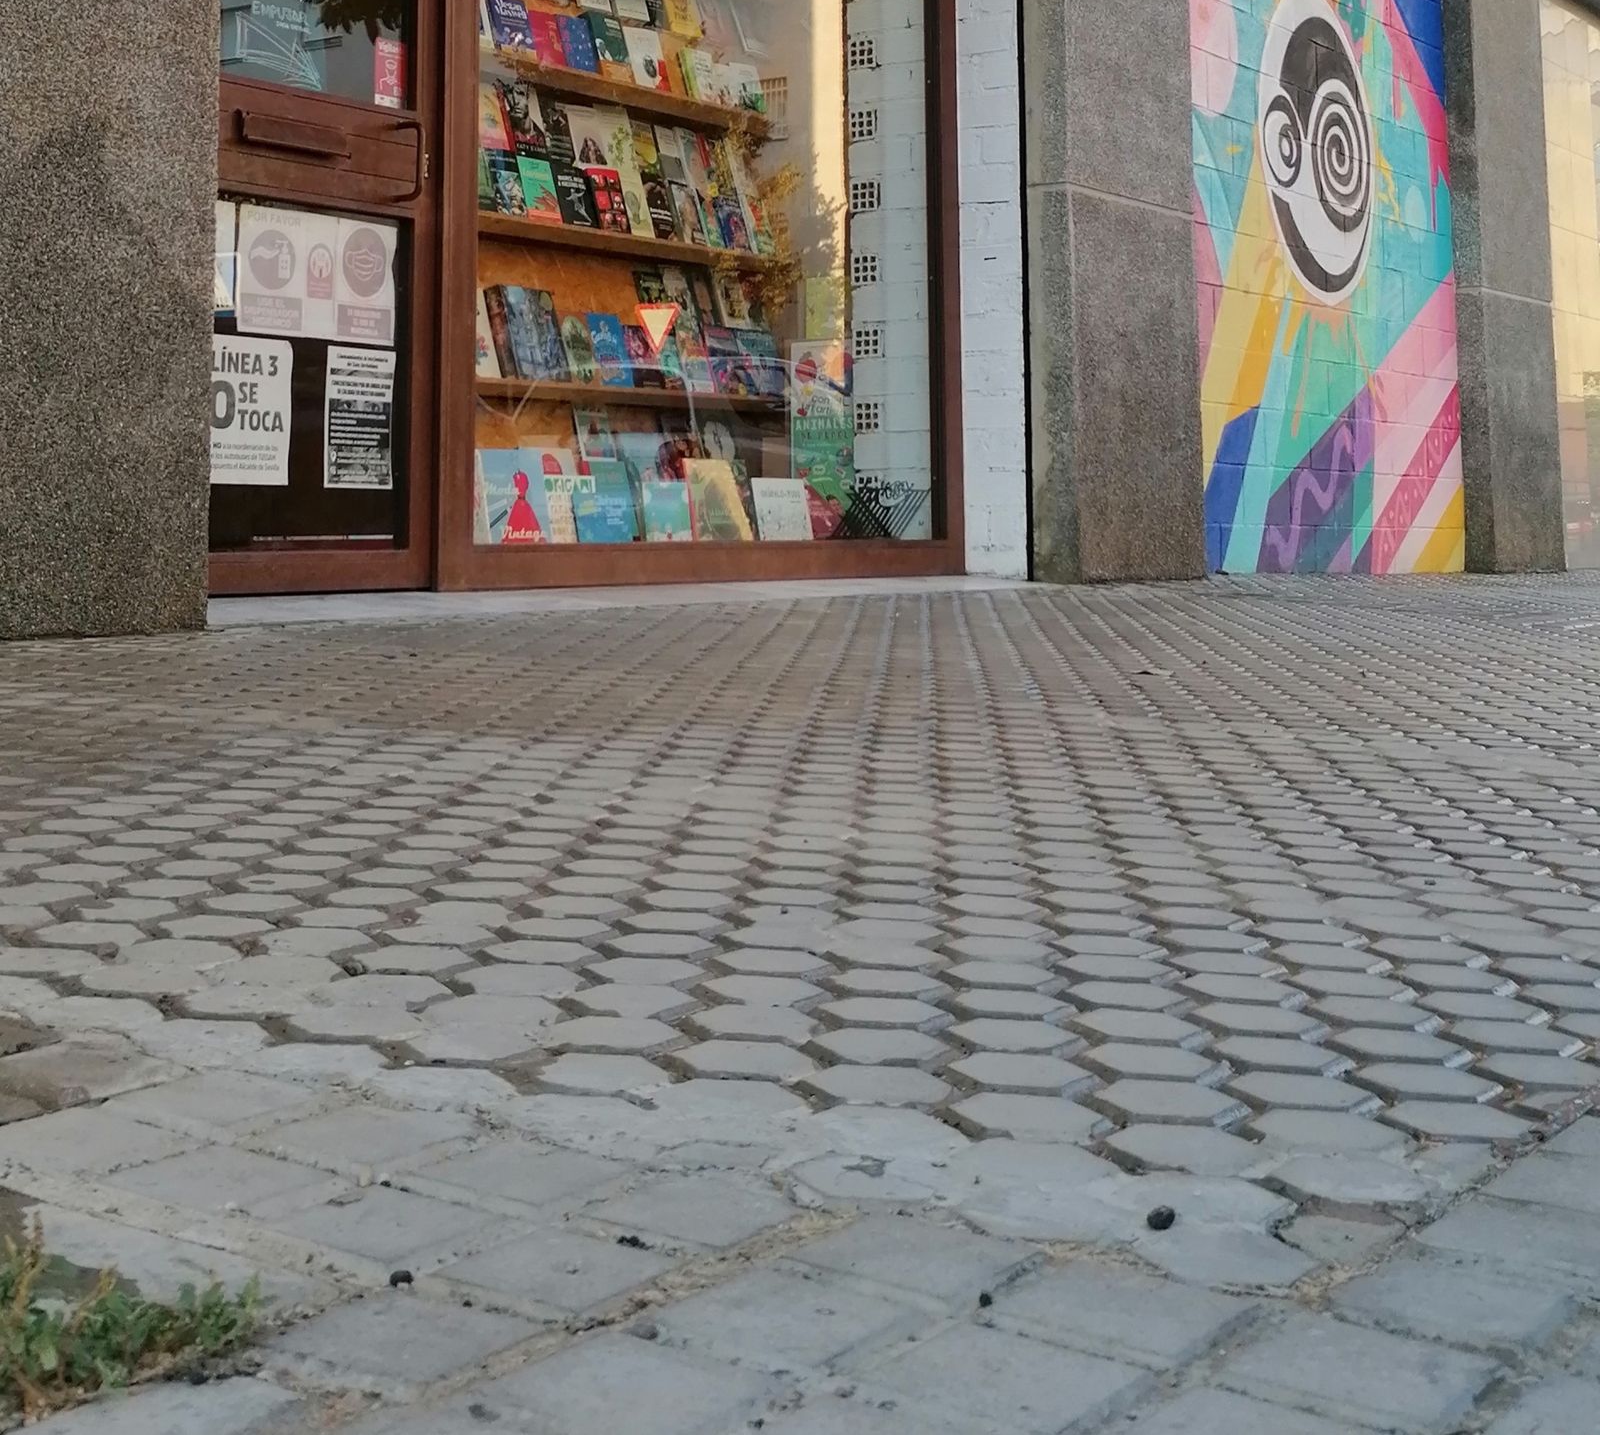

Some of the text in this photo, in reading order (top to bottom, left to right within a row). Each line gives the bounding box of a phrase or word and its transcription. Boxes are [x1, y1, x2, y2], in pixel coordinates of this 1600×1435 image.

[212, 346, 279, 377] LÍNEA 3
[238, 381, 259, 404] SE
[237, 408, 284, 433] TOCA
